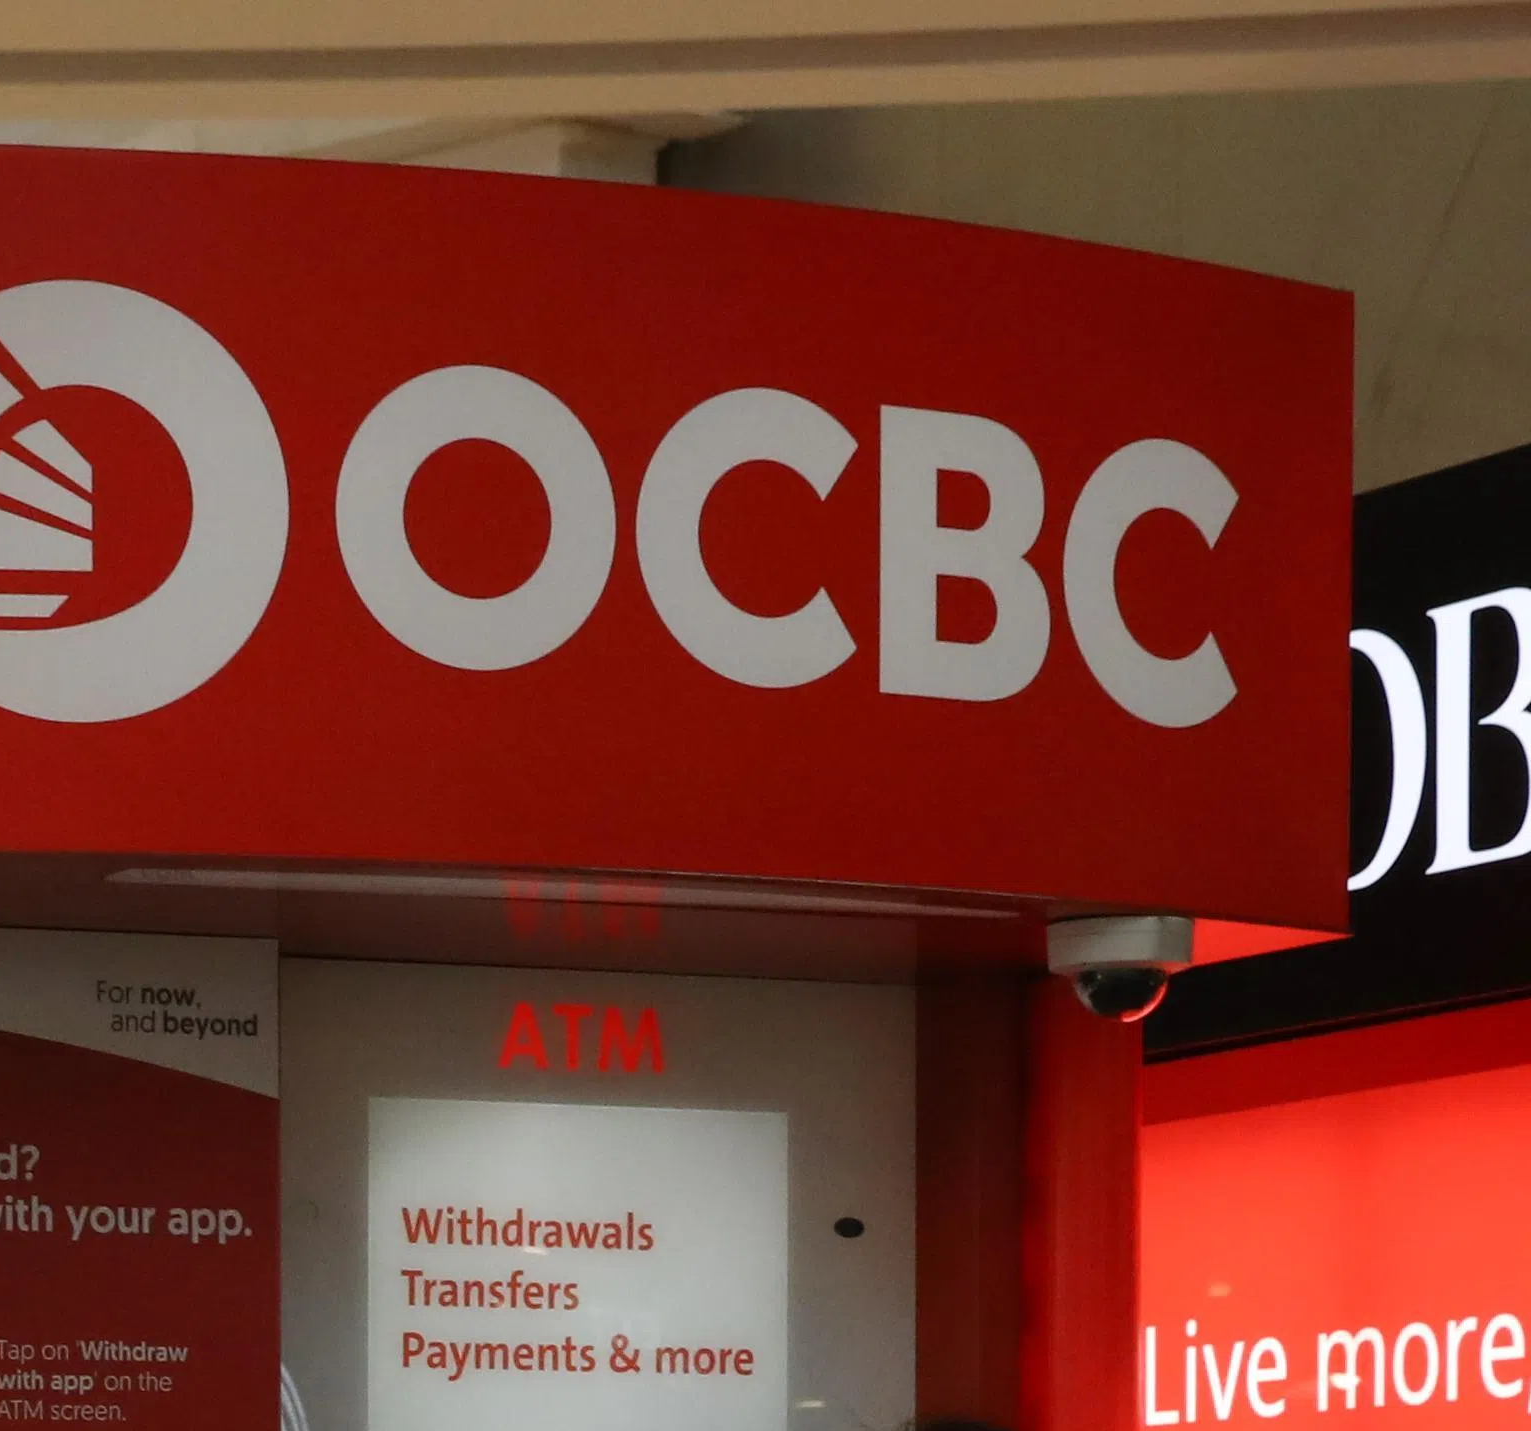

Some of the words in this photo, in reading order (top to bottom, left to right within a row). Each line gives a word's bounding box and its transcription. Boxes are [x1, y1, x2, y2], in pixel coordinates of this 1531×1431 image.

[335, 365, 1239, 728] OCBC
[96, 981, 133, 1003] For
[140, 984, 202, 1009] now,
[110, 1010, 156, 1034] and
[162, 1011, 258, 1040] beyond
[498, 1001, 666, 1073] ATM
[65, 1203, 156, 1241] your
[168, 1206, 253, 1245] app.
[401, 1207, 654, 1252] Withdrawals
[401, 1270, 580, 1310] Transfers
[41, 1345, 70, 1362] on
[401, 1332, 596, 1381] Payments
[609, 1334, 641, 1374] &
[654, 1342, 755, 1377] more
[1144, 1319, 1288, 1427] Live
[104, 1375, 133, 1392] on
[138, 1371, 173, 1392] the
[50, 1403, 127, 1422] screen.
